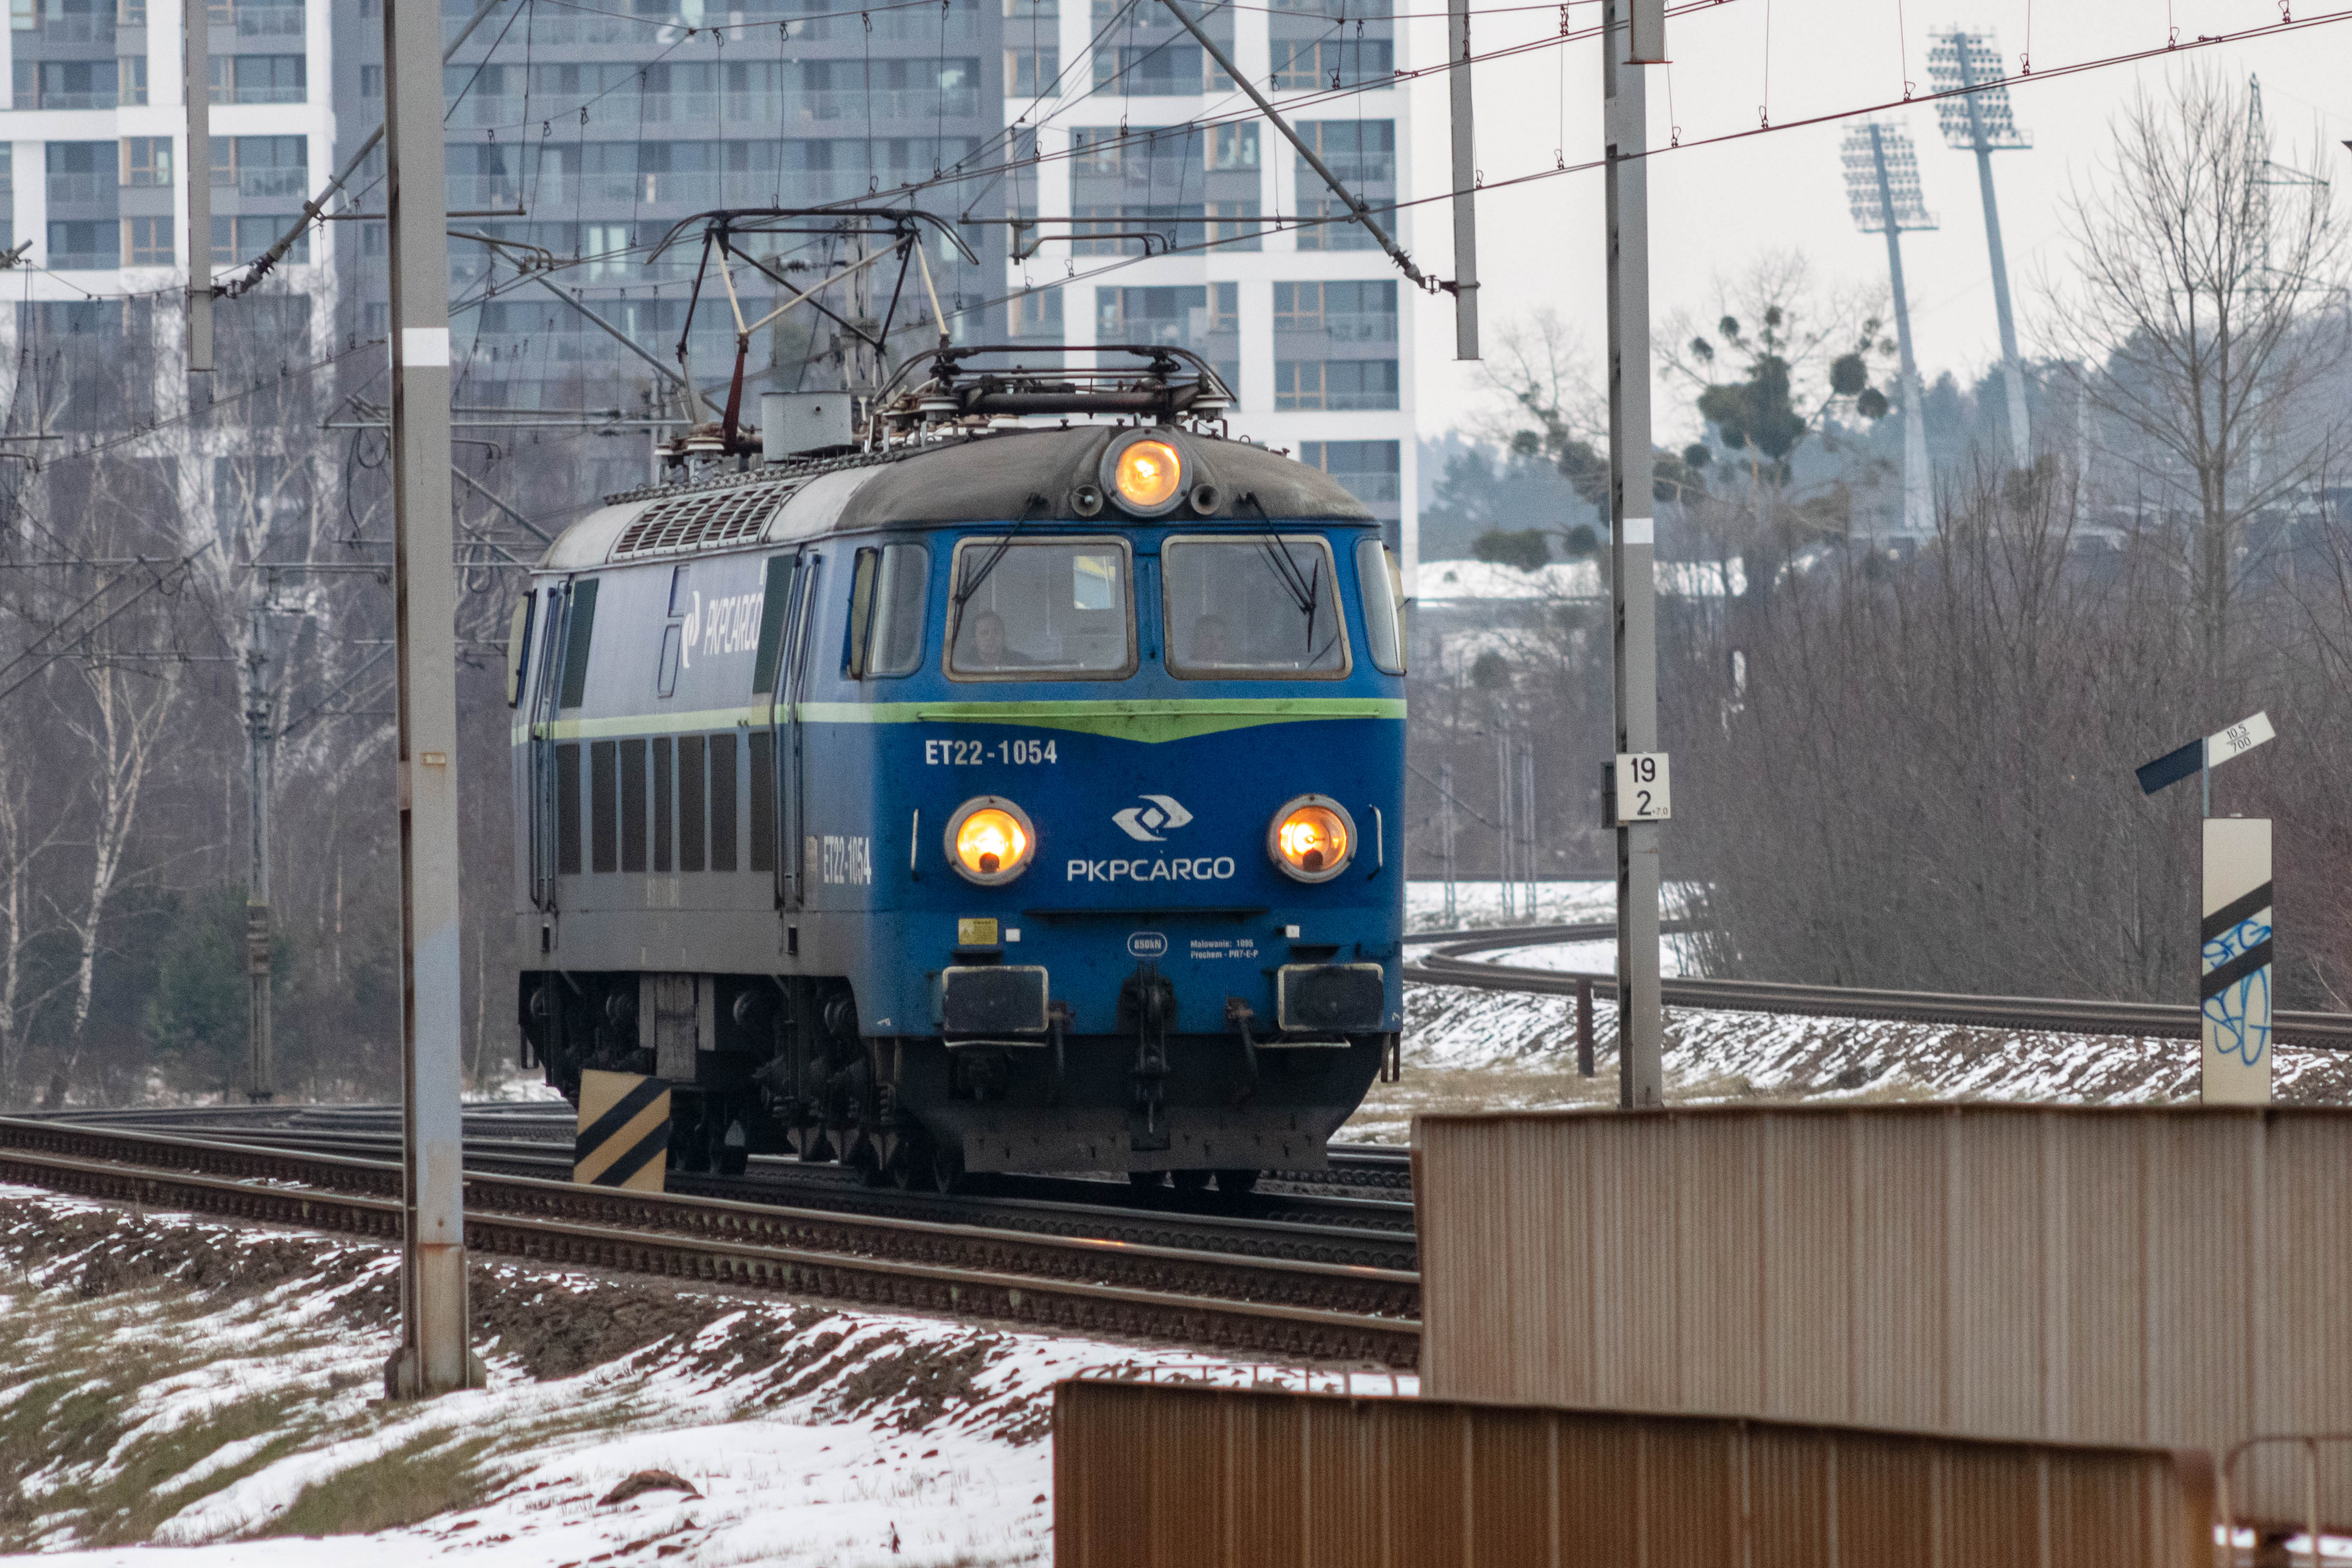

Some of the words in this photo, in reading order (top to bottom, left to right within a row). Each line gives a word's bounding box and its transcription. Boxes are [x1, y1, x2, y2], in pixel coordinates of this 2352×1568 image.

[925, 739, 1058, 765] ET22-1054
[2230, 736, 2251, 753] 700
[1631, 757, 1656, 783] 19
[1637, 790, 1652, 816] 2
[1067, 857, 1235, 882] PKPCARGO
